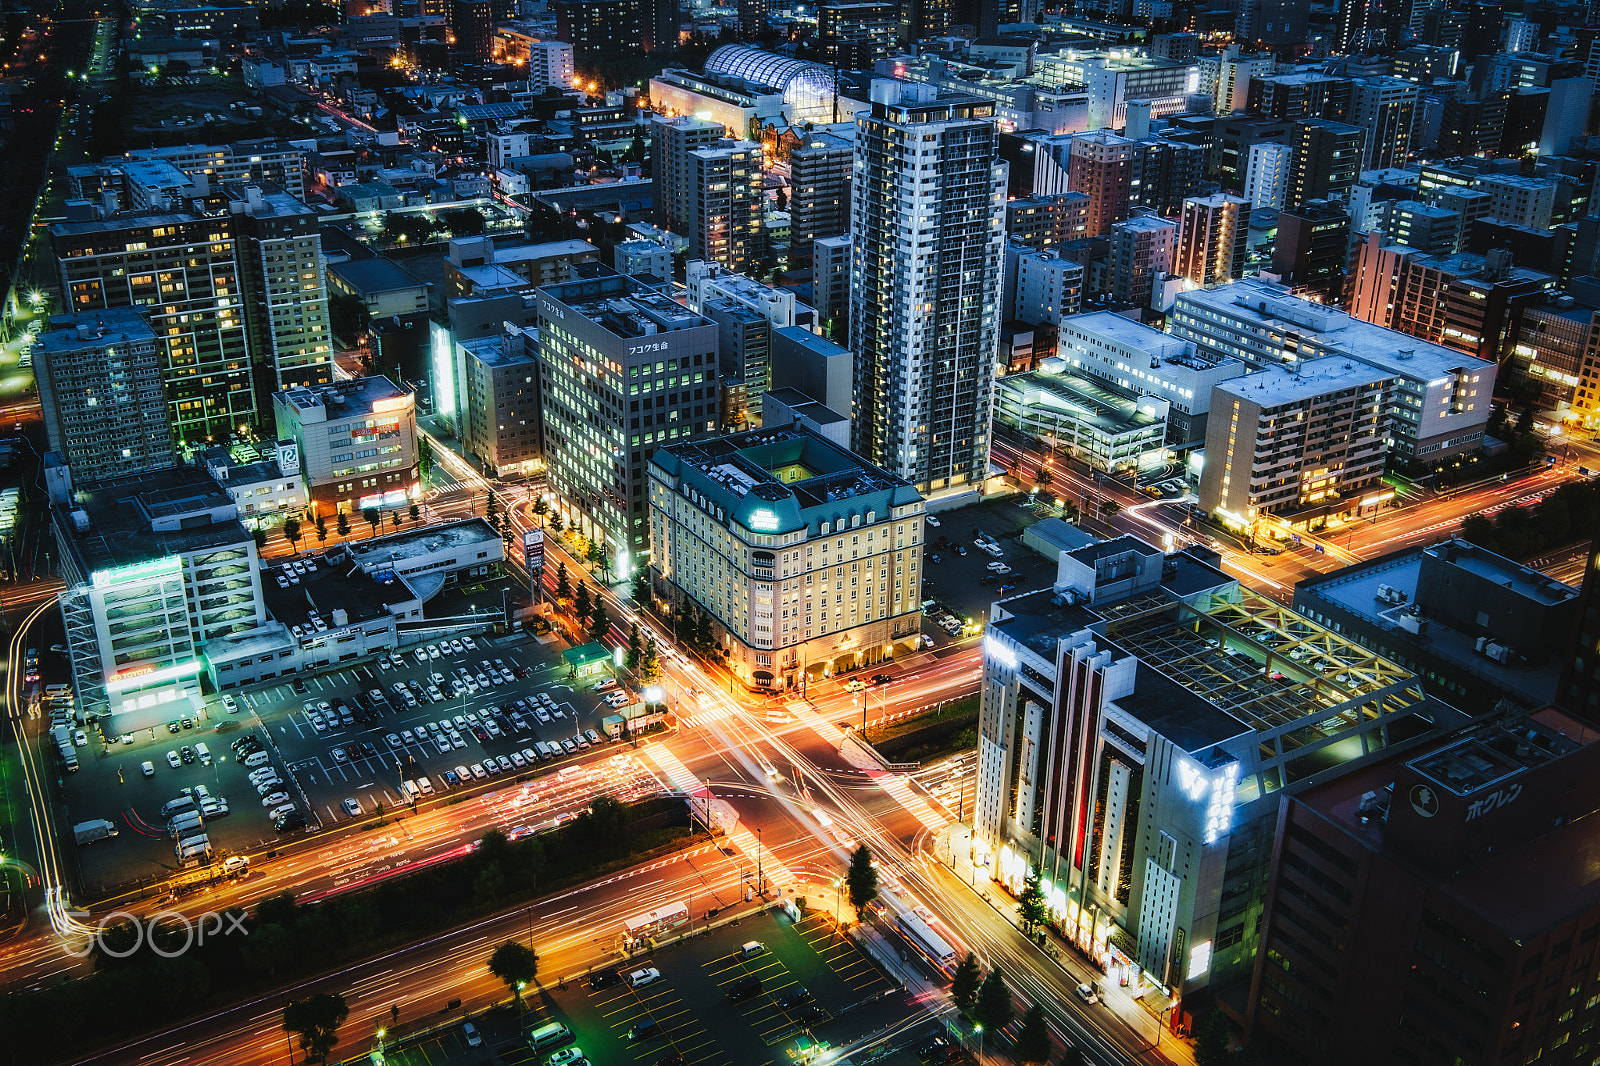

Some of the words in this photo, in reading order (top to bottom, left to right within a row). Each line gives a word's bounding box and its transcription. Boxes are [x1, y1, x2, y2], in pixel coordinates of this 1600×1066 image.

[628, 341, 669, 355] フコク生命
[122, 667, 153, 679] TOYOTA
[1203, 776, 1225, 844] VEGAS
[1464, 783, 1523, 823] ホクレン
